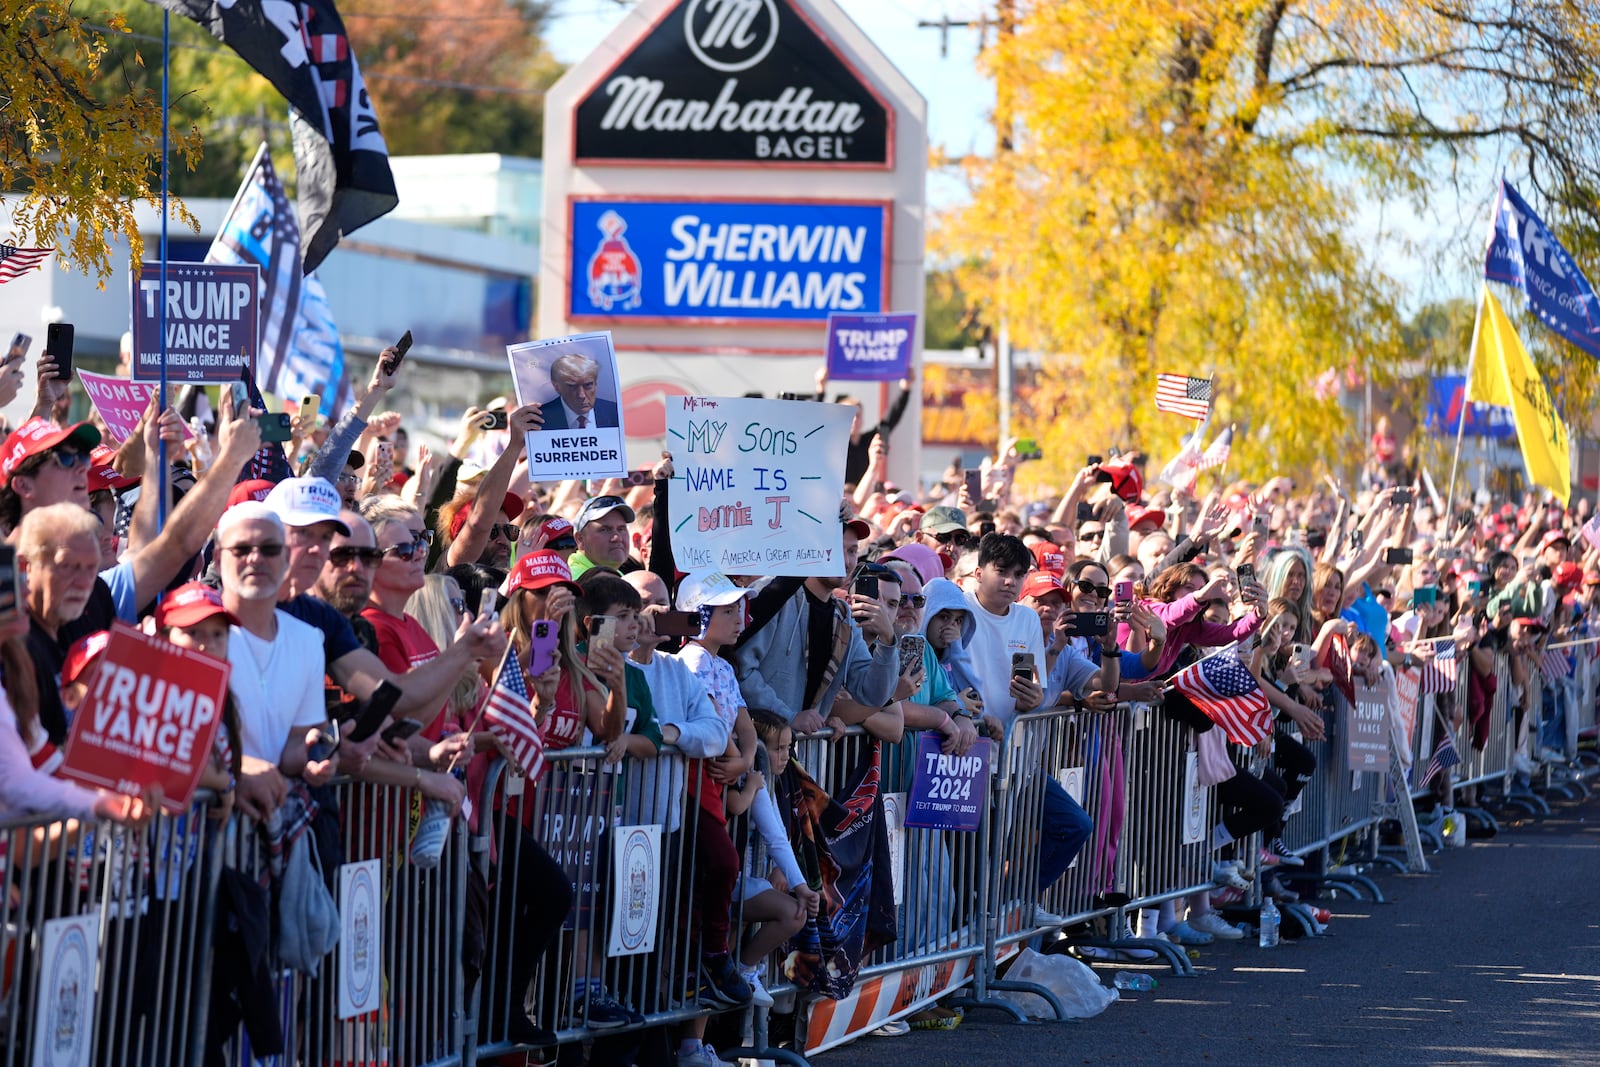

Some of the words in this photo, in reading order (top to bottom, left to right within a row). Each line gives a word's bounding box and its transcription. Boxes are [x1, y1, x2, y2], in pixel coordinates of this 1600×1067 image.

[601, 76, 865, 133] Manhattan
[754, 135, 848, 159] BAGEL
[665, 214, 867, 263] SHERWIN
[663, 261, 866, 310] WILLIAMS
[1525, 263, 1558, 302] MERICA
[140, 279, 252, 320] TRUMP
[164, 323, 231, 350] VANCE
[835, 328, 908, 347] TRUMP
[140, 353, 162, 367] MAKE
[164, 353, 198, 367] AMERICA
[198, 354, 225, 368] GREAT
[842, 346, 898, 361] VANCE
[187, 370, 205, 380] 2024
[113, 407, 141, 422] FOR
[551, 436, 598, 449] NEVER
[687, 419, 728, 454] MY
[534, 449, 618, 464] SURRENDER
[686, 466, 735, 492] NAME
[753, 468, 788, 491] IS
[525, 555, 549, 568] MAKE
[681, 546, 713, 566] MAKE
[765, 547, 791, 561] GREAT
[795, 548, 832, 562] AGAIN!
[530, 565, 556, 577] GREAT
[94, 661, 216, 732] TRUMP
[93, 699, 197, 763] VANCE
[1358, 723, 1381, 735] VANCE
[925, 752, 983, 778] TRUMP
[927, 776, 972, 801] 2024
[915, 801, 931, 811] TEXT
[931, 802, 952, 812] TRUMP
[952, 804, 960, 813] TO
